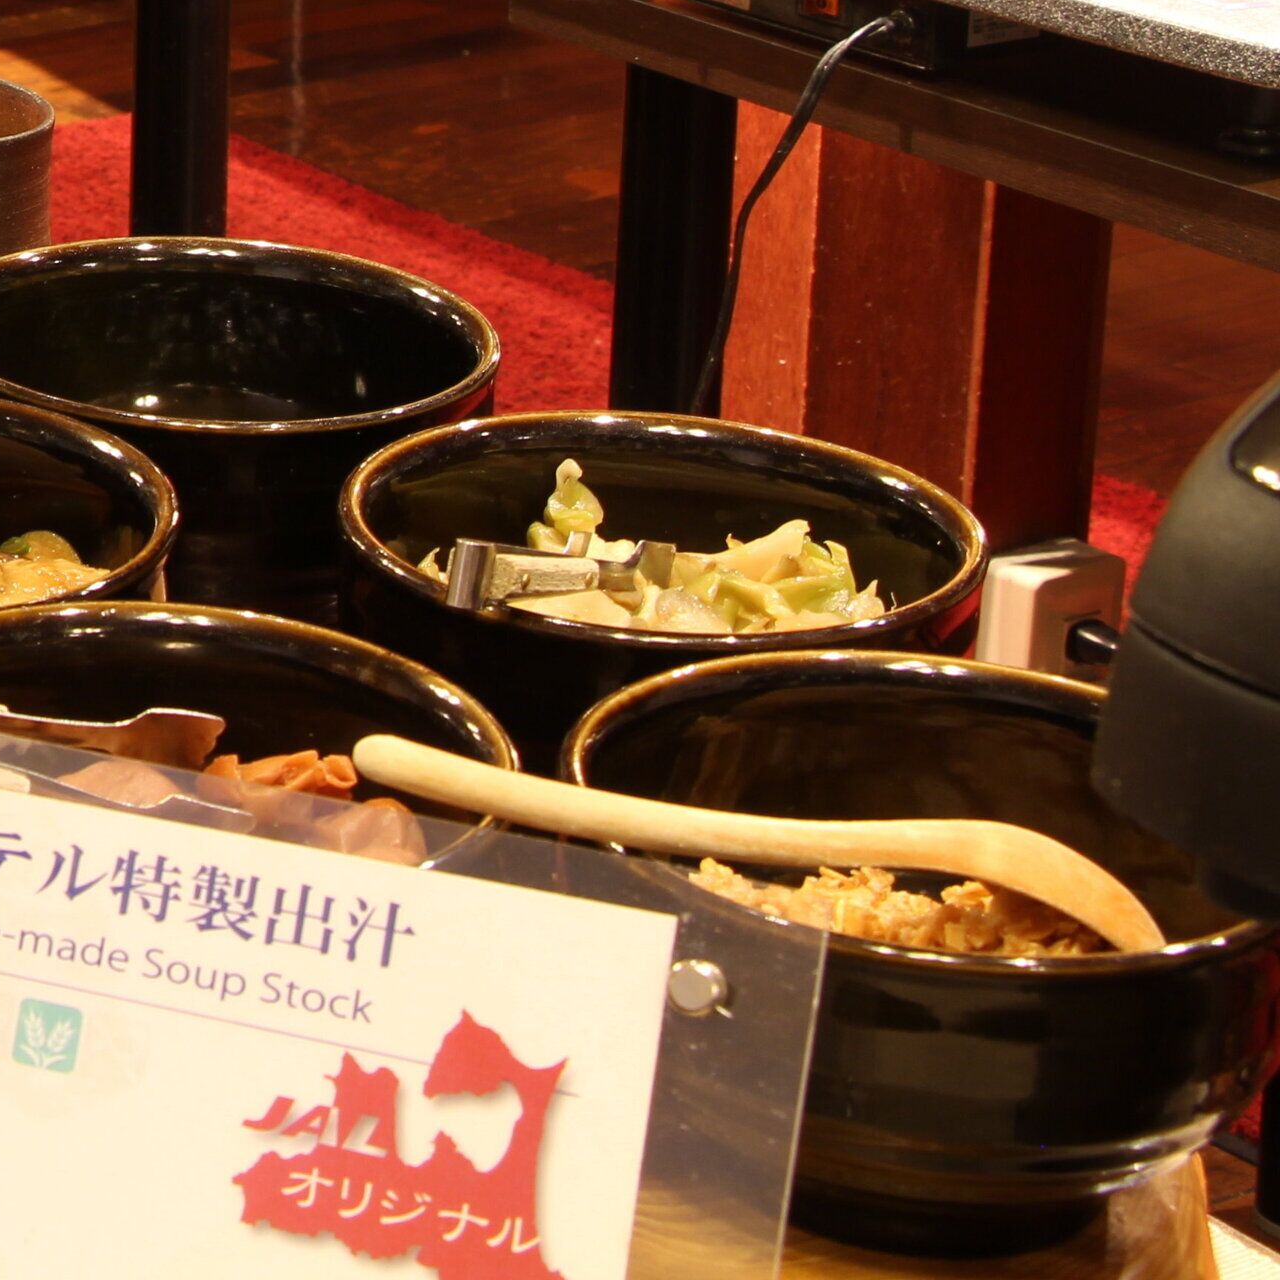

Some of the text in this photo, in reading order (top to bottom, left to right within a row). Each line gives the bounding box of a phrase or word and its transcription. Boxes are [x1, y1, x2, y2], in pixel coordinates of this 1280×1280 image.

[142, 947, 247, 1001] Soup
[259, 971, 374, 1025] Stock
[241, 1095, 388, 1158] JAL
[281, 1167, 541, 1253] オリジナル
